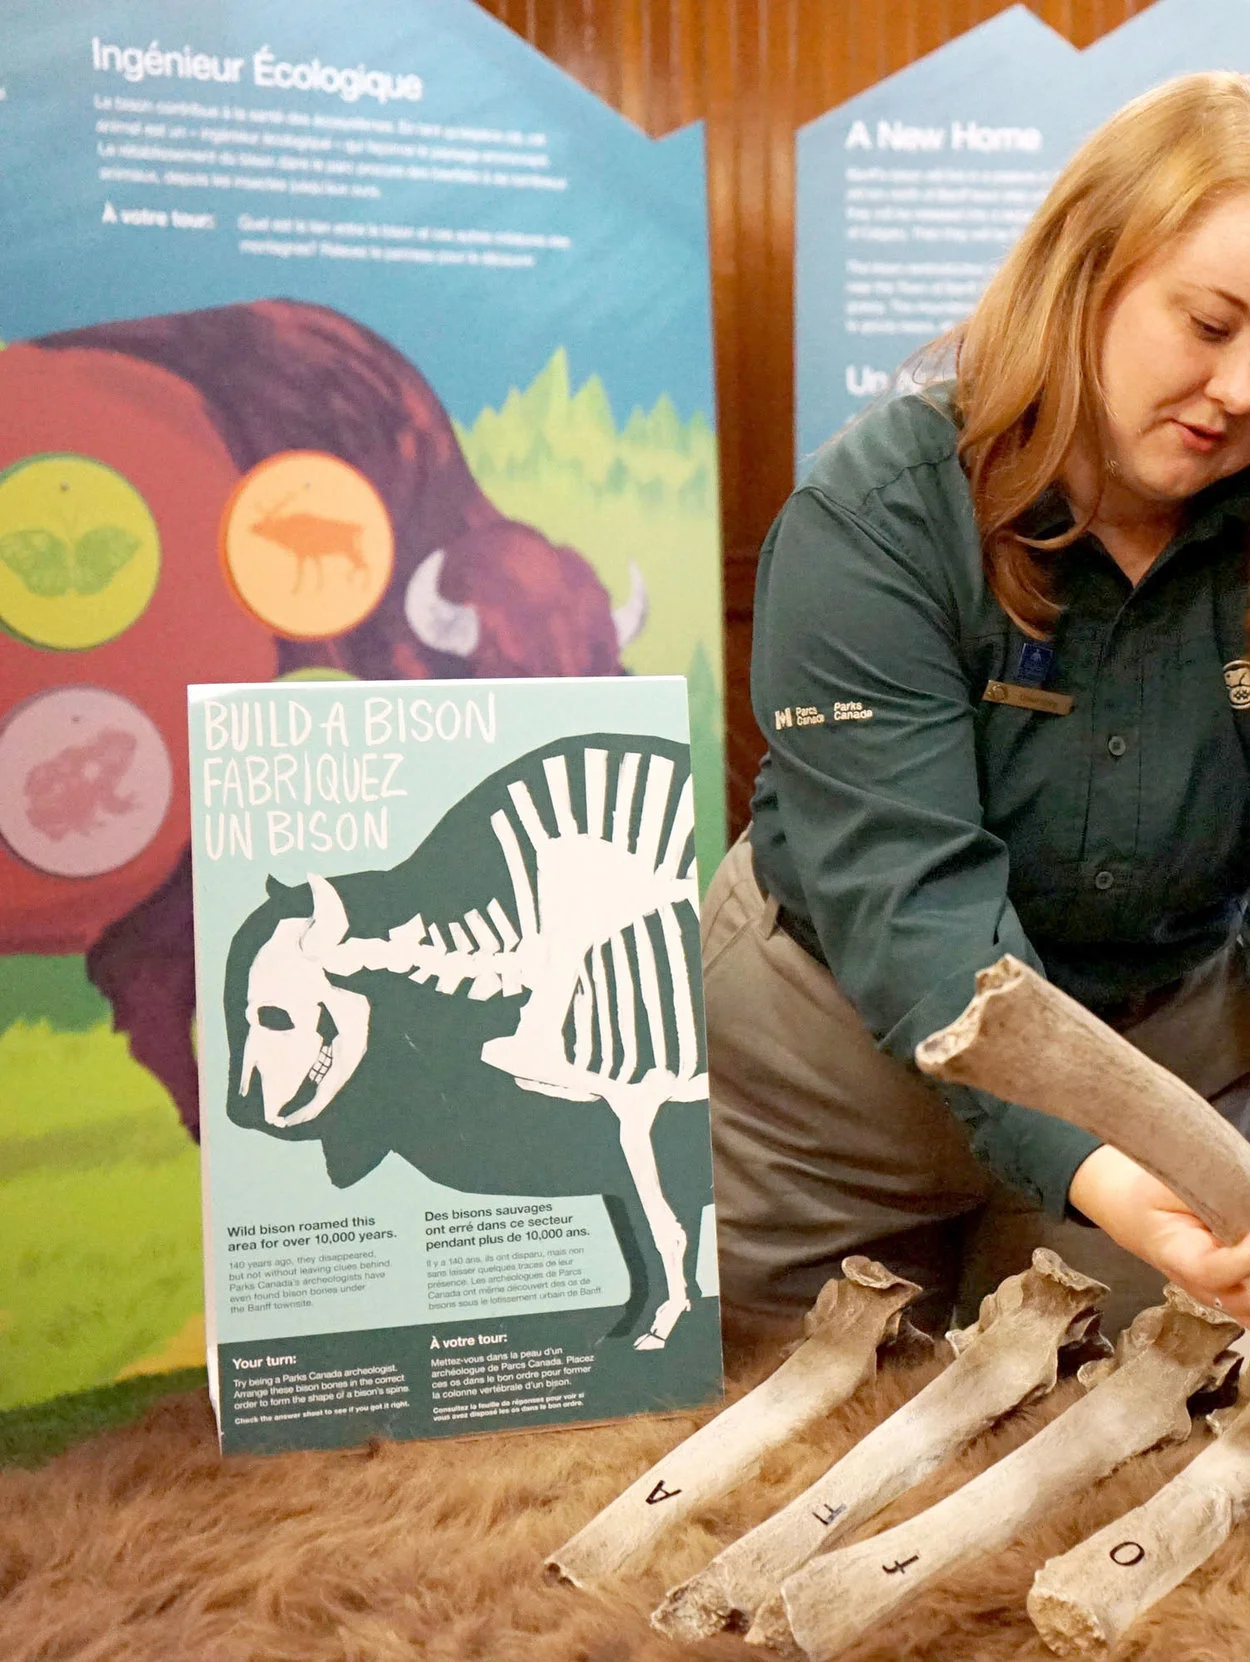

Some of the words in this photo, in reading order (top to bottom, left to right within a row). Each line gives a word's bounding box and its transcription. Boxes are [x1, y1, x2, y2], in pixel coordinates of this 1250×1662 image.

[91, 37, 244, 82] Ingénieur
[253, 44, 424, 102] Écologique
[845, 120, 873, 150] A
[876, 120, 945, 151] New
[950, 120, 1044, 151] Home
[834, 702, 863, 711] Parks
[834, 710, 873, 720] Canada
[204, 700, 312, 752] BUILD
[319, 701, 349, 746] A
[364, 692, 496, 746] BISON
[203, 752, 408, 808] FABRIQUEZ
[204, 812, 252, 861] UN
[267, 806, 388, 855] BISON
[425, 1211, 448, 1221] Des
[452, 1209, 492, 1219] bisons
[496, 1204, 552, 1216] sauvages
[228, 1226, 256, 1237] Wild
[260, 1224, 295, 1235] bison
[299, 1218, 348, 1231] roamed
[353, 1216, 375, 1227] this
[426, 1225, 445, 1236] ont
[449, 1223, 473, 1234] erré
[477, 1222, 506, 1231] dans
[511, 1220, 524, 1228] ce
[528, 1215, 573, 1227] secteur
[228, 1242, 256, 1252] area
[261, 1239, 278, 1249] for
[283, 1237, 310, 1247] over
[316, 1231, 355, 1246] 10,000
[359, 1230, 397, 1243] years.
[426, 1235, 475, 1251] pendant
[479, 1234, 503, 1247] plus
[507, 1232, 521, 1242] de
[526, 1228, 562, 1242] 10,000
[566, 1228, 589, 1237] ans.
[229, 1261, 244, 1270] 140
[248, 1260, 272, 1271] years
[297, 1256, 315, 1266] they
[229, 1272, 244, 1281] but
[247, 1270, 261, 1279] not
[265, 1267, 296, 1278] without
[300, 1265, 331, 1275] leaving
[334, 1263, 357, 1272] clues
[230, 1282, 255, 1292] Parks
[303, 1273, 362, 1285] archeologists
[365, 1272, 385, 1280] have
[230, 1295, 250, 1303] even
[254, 1291, 280, 1300] found
[283, 1289, 307, 1298] bison
[311, 1287, 337, 1295] bones
[341, 1284, 365, 1293] under
[231, 1305, 244, 1314] the
[248, 1302, 271, 1312] Banff
[430, 1336, 440, 1349] À
[443, 1336, 475, 1348] votre
[479, 1332, 507, 1344] tour:
[233, 1359, 262, 1370] Your
[267, 1353, 297, 1367] turn:
[431, 1355, 484, 1367] Mettez-vous
[487, 1353, 508, 1361] dans
[511, 1351, 518, 1359] la
[520, 1350, 541, 1360] peau
[488, 1364, 499, 1372] de
[502, 1363, 525, 1371] Parcs
[567, 1356, 594, 1365] Placez
[234, 1379, 246, 1390] Try
[249, 1377, 272, 1387] being
[283, 1373, 307, 1383] Parks
[309, 1370, 342, 1380] Canada
[234, 1389, 268, 1399] Arrange
[270, 1386, 293, 1395] these
[296, 1384, 319, 1392] bison
[322, 1381, 347, 1390] bones
[350, 1379, 357, 1387] in
[360, 1377, 372, 1386] the
[375, 1373, 405, 1384] correct
[432, 1381, 447, 1389] ces
[463, 1377, 484, 1385] dans
[487, 1375, 494, 1383] le
[497, 1374, 513, 1382] bon
[516, 1371, 539, 1380] ordre
[542, 1369, 560, 1380] pour
[564, 1366, 591, 1375] former
[234, 1401, 257, 1410] order
[260, 1399, 268, 1407] to
[271, 1398, 290, 1406] form
[293, 1395, 306, 1404] the
[308, 1393, 334, 1403] shape
[336, 1391, 344, 1399] of
[433, 1392, 440, 1400] la
[443, 1389, 477, 1398] colonne
[645, 1480, 682, 1505] A
